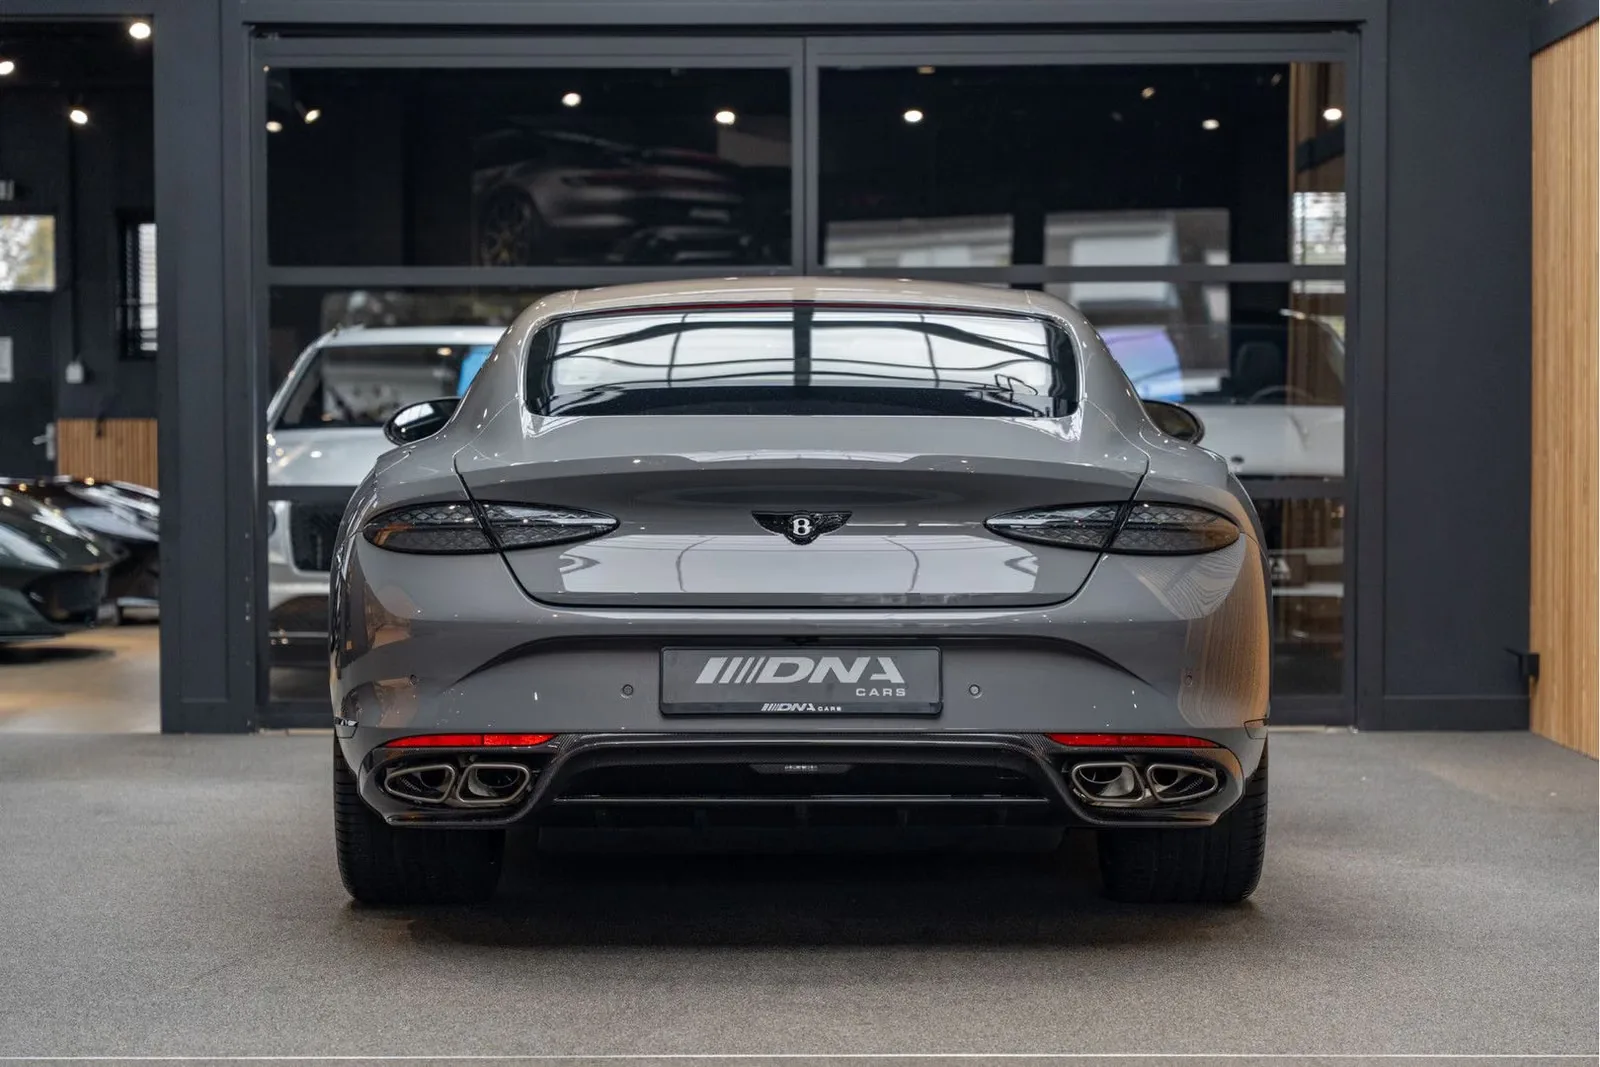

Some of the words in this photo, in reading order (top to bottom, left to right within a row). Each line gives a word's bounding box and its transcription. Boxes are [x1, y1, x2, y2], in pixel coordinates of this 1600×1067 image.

[793, 518, 812, 535] B
[755, 656, 905, 684] DNA
[855, 687, 906, 697] CARS
[777, 703, 816, 712] DNA
